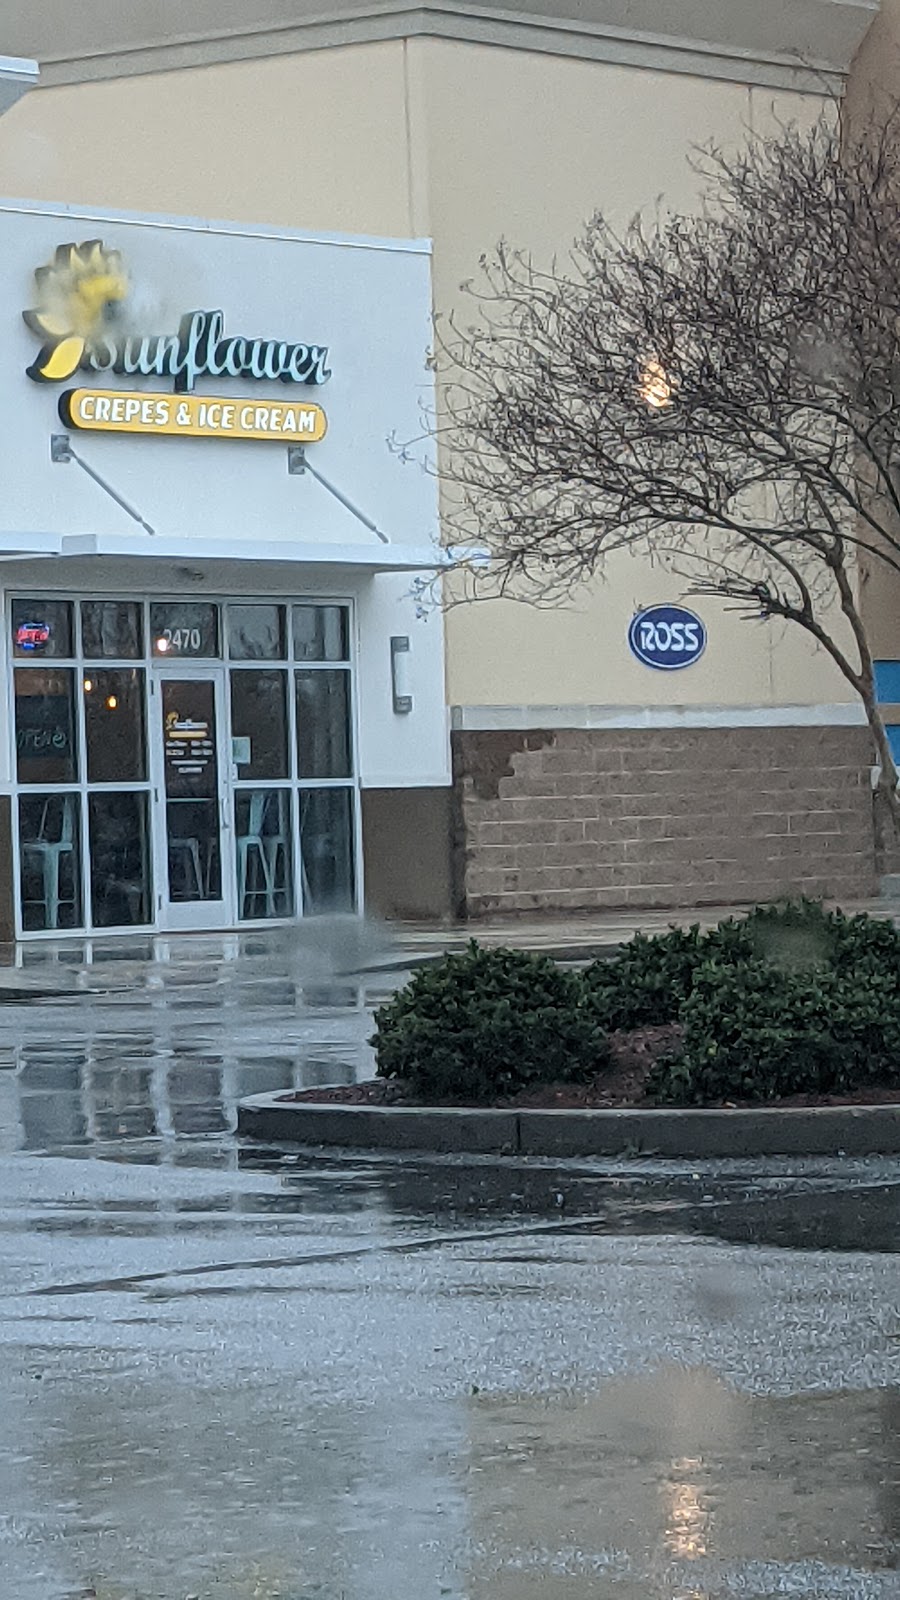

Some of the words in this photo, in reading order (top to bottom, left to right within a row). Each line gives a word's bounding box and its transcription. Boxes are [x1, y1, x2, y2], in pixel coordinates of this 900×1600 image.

[86, 310, 331, 390] Sunflower
[79, 397, 170, 425] CREPES
[176, 402, 192, 426] &
[199, 404, 235, 429] ICE
[240, 407, 317, 432] CREAM
[161, 628, 201, 650] 2470
[640, 621, 699, 652] ROSS
